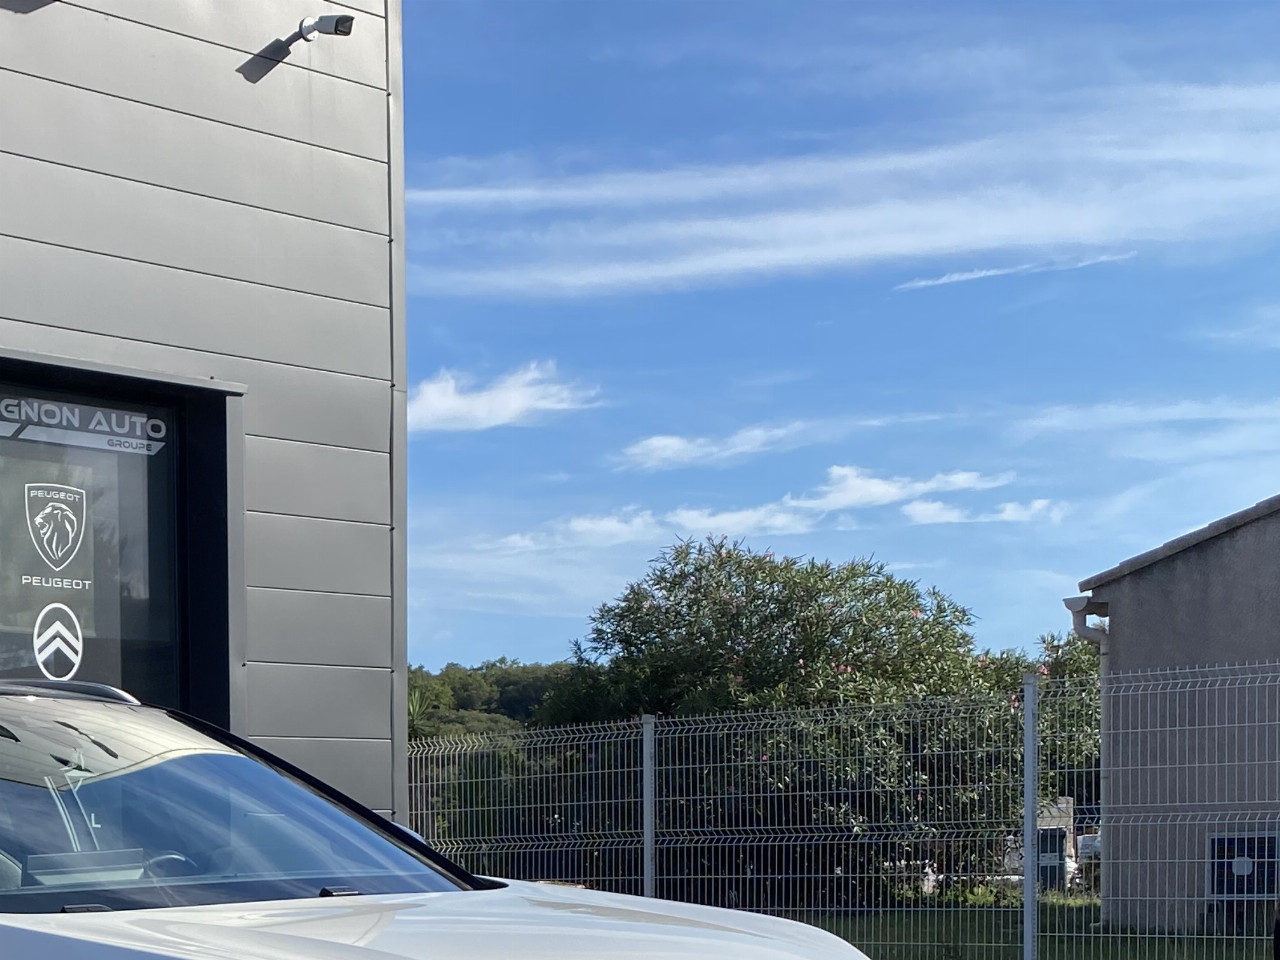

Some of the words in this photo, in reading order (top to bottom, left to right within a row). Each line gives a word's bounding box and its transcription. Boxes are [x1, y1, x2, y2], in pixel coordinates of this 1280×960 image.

[88, 411, 167, 439] AUTO
[107, 439, 153, 452] GROUPE
[30, 490, 81, 502] PEUGEOT
[21, 576, 92, 590] PEUGEOT
